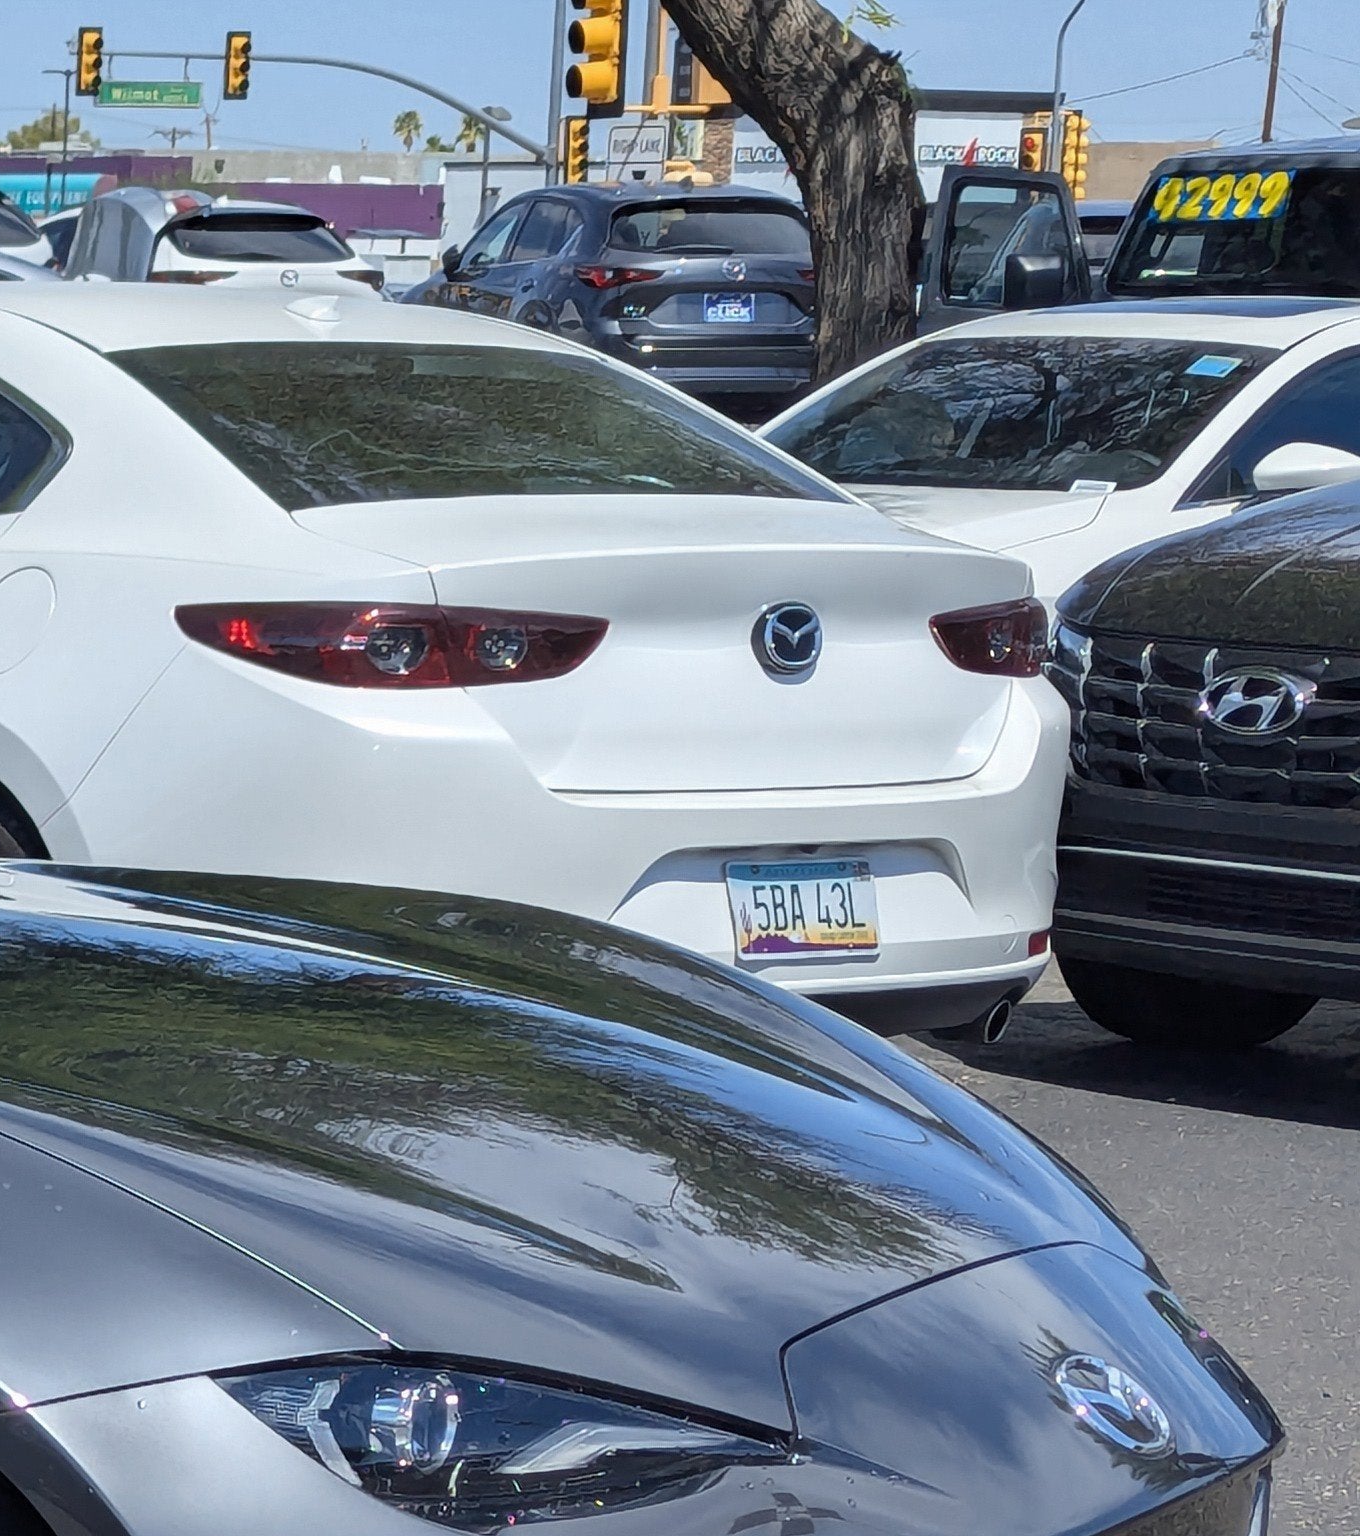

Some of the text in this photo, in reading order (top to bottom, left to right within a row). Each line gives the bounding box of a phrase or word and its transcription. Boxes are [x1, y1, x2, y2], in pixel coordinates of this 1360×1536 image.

[111, 88, 159, 101] Wilmot
[919, 145, 1018, 164] BLACK ROCK
[26, 189, 88, 206] EQUPMENT
[1153, 171, 1290, 222] 42999
[752, 881, 867, 932] 5BA 43L
